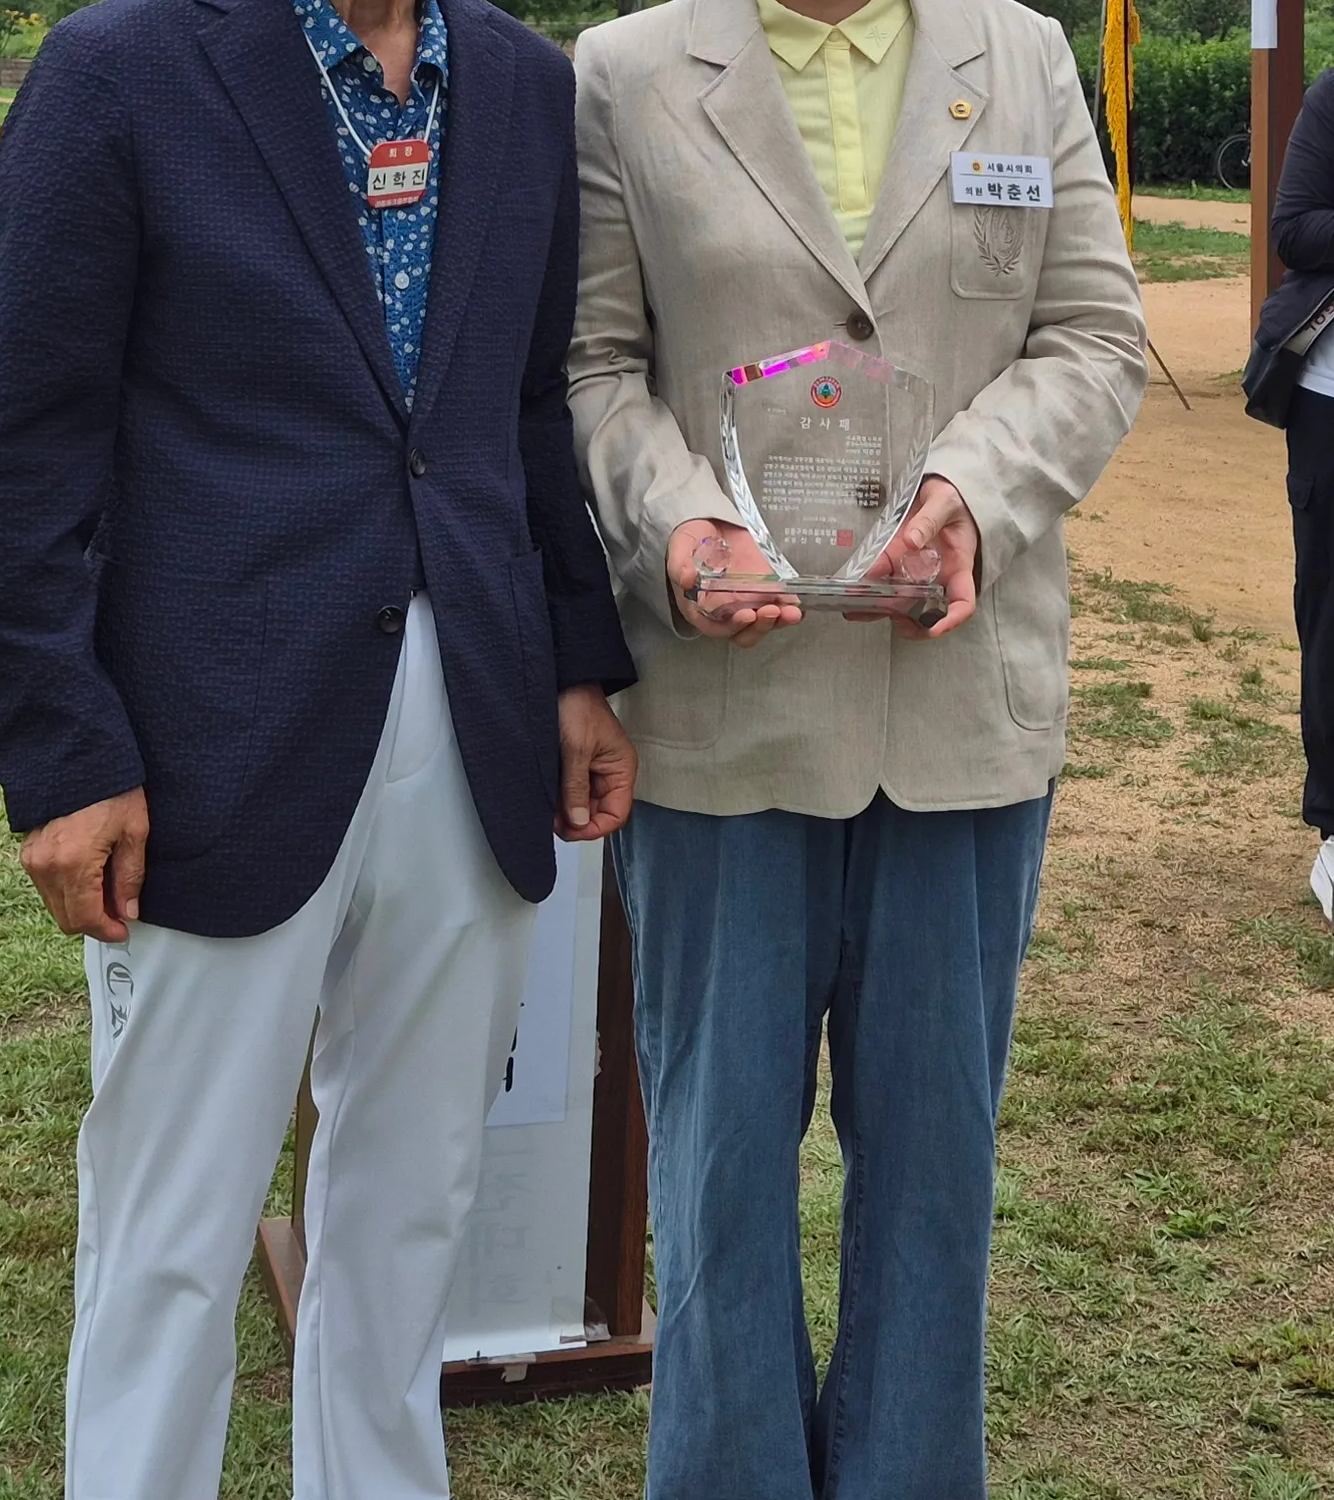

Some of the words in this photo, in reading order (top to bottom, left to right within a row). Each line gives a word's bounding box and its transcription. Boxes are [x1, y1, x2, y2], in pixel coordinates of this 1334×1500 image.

[987, 162, 1033, 174] 서울시의회
[965, 186, 983, 197] 의원
[987, 182, 1041, 202] 박춘선
